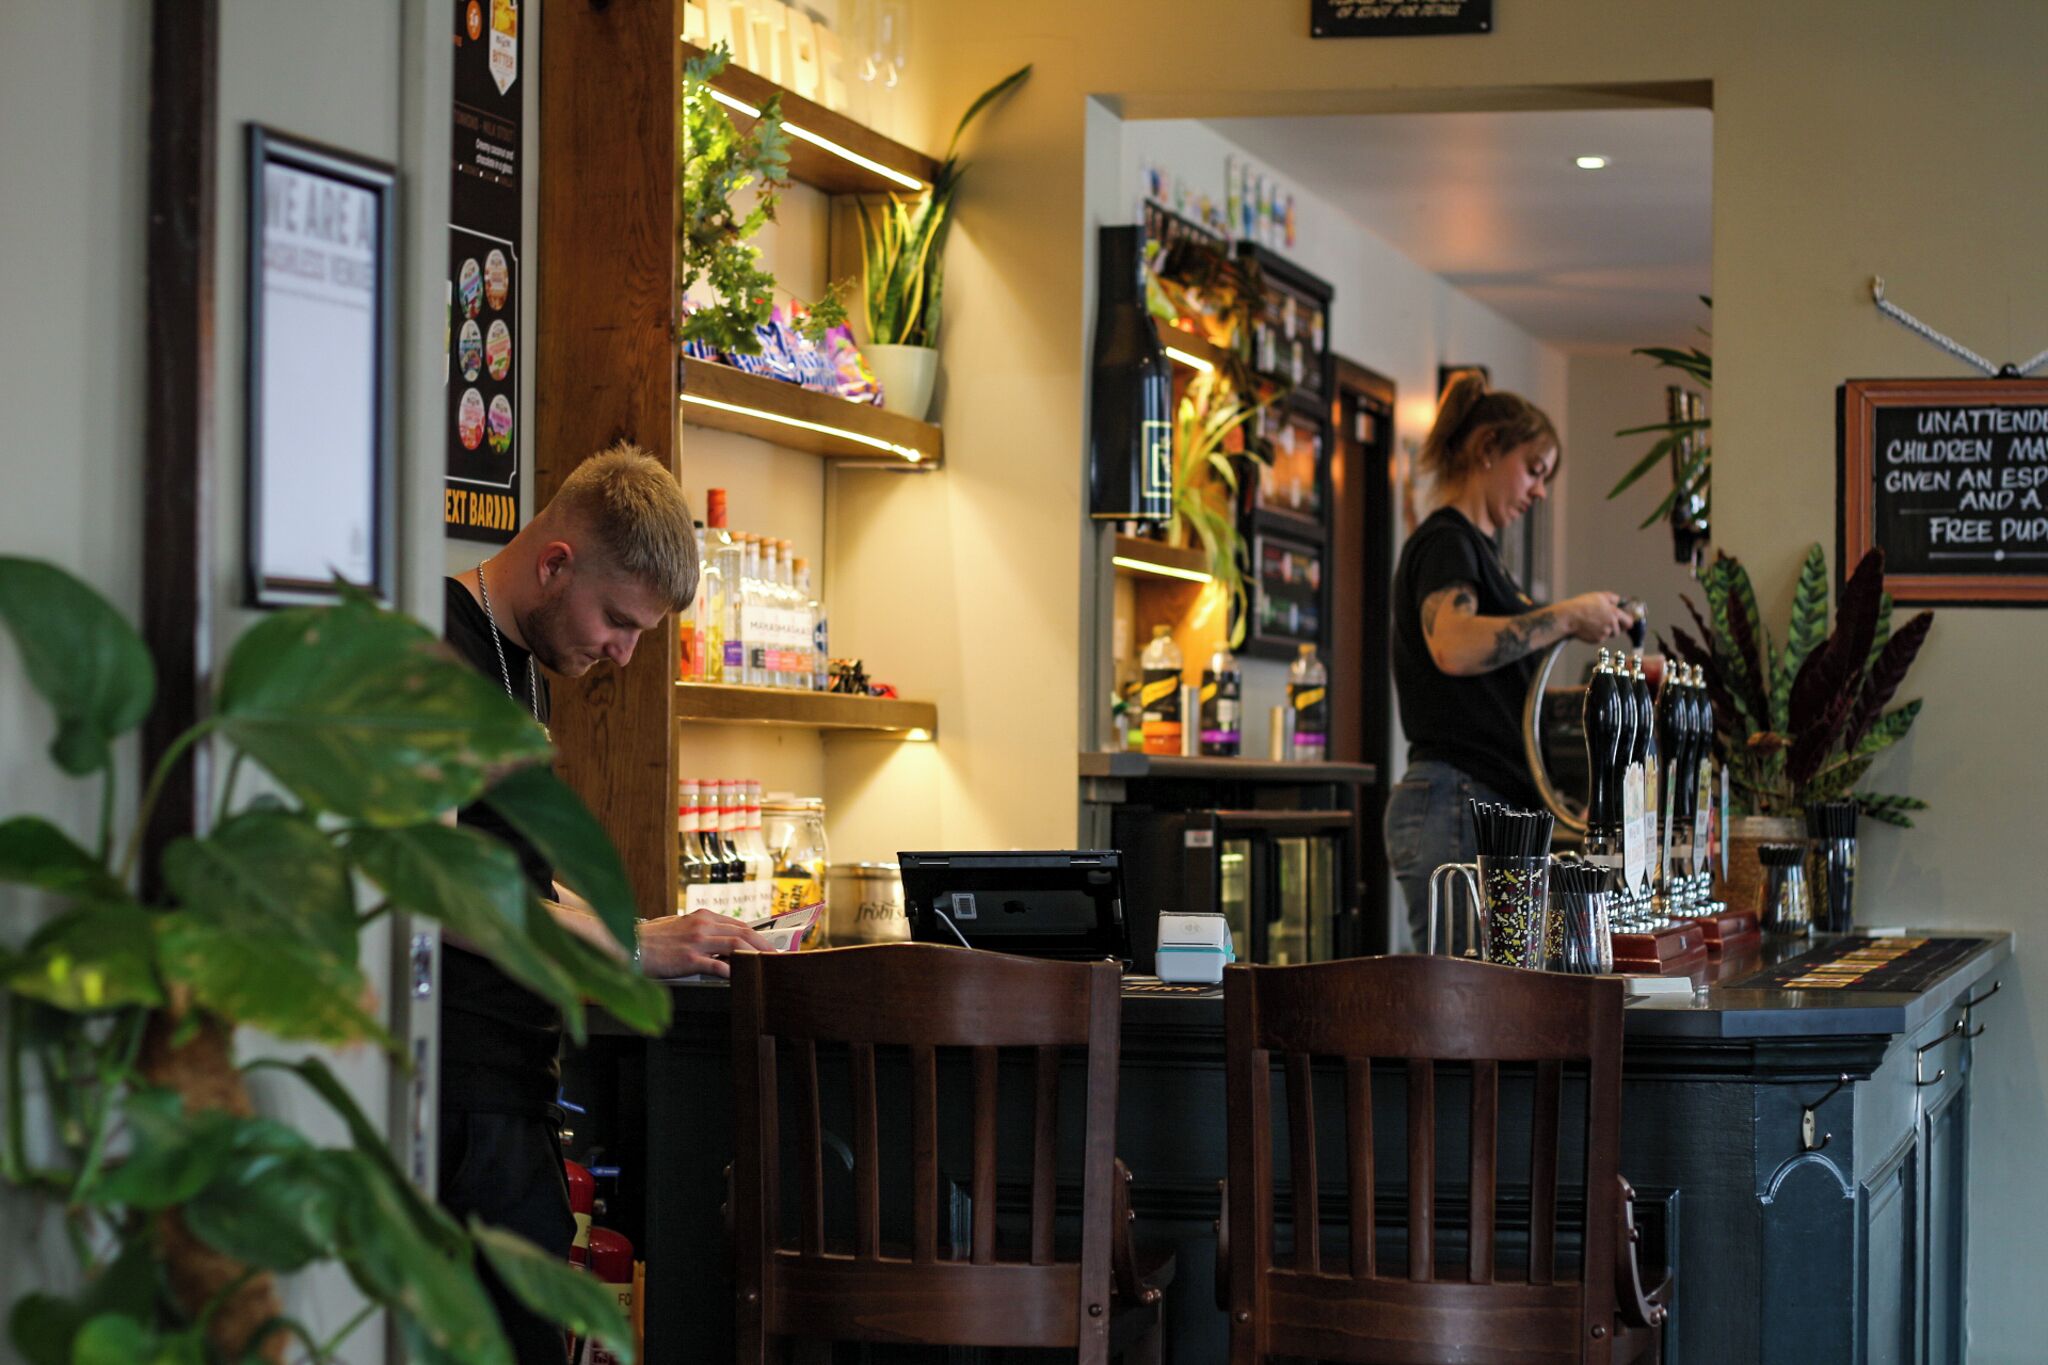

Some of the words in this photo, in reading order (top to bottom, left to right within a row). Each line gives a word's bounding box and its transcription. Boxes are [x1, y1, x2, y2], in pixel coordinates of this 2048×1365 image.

[1886, 438, 1993, 464] CHILDREN
[1885, 469, 1950, 493] GIVEN
[1956, 467, 1993, 490] AN
[445, 488, 467, 525] EXT
[469, 491, 494, 528] BAR
[1959, 490, 2015, 511] AND
[2020, 488, 2043, 511] A
[1929, 516, 1994, 544] FREE
[2001, 517, 2048, 543] PUP
